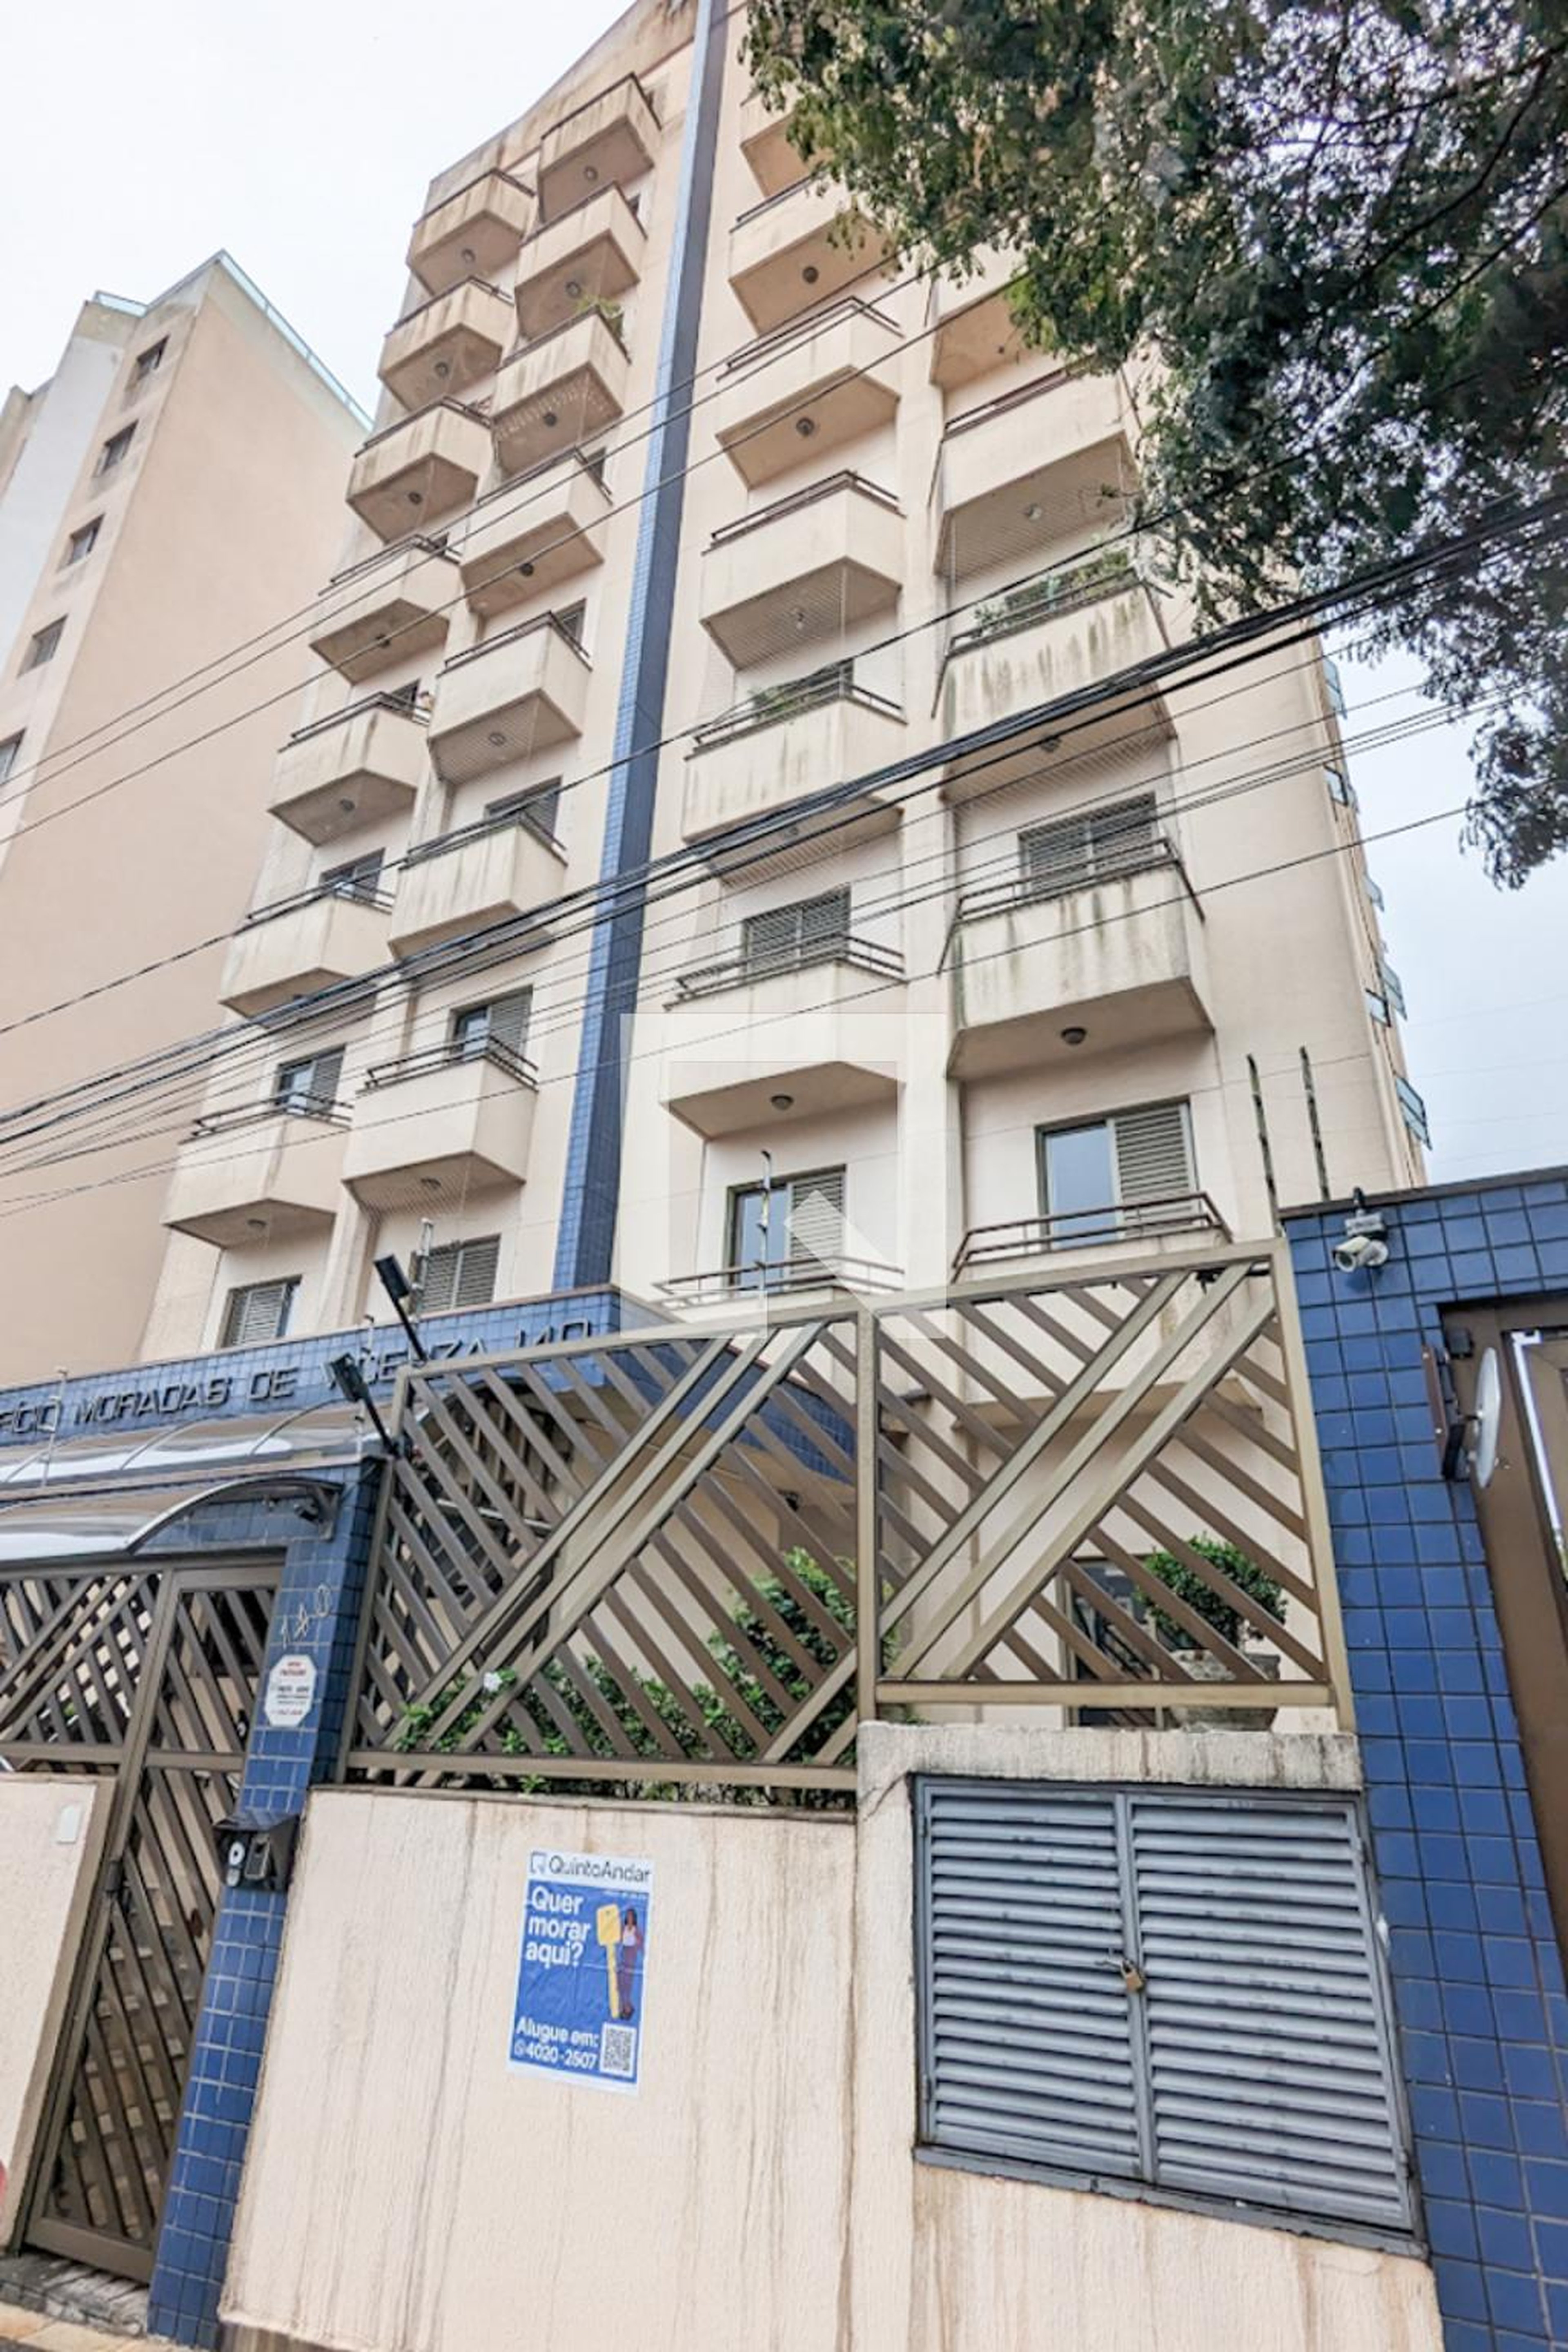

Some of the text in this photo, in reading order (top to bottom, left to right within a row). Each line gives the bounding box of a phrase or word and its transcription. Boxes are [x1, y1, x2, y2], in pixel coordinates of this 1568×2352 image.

[75, 1377, 233, 1424] MORADAS
[249, 1367, 299, 1401] DE
[320, 1337, 488, 1389] VCEZA
[281, 1584, 332, 1650] 140
[549, 1855, 650, 1882] QuintoAndar
[532, 1885, 584, 1915] Quer
[528, 1915, 591, 1942] morar
[526, 1940, 584, 1969] aqui?
[516, 2016, 600, 2048] Alugue em:
